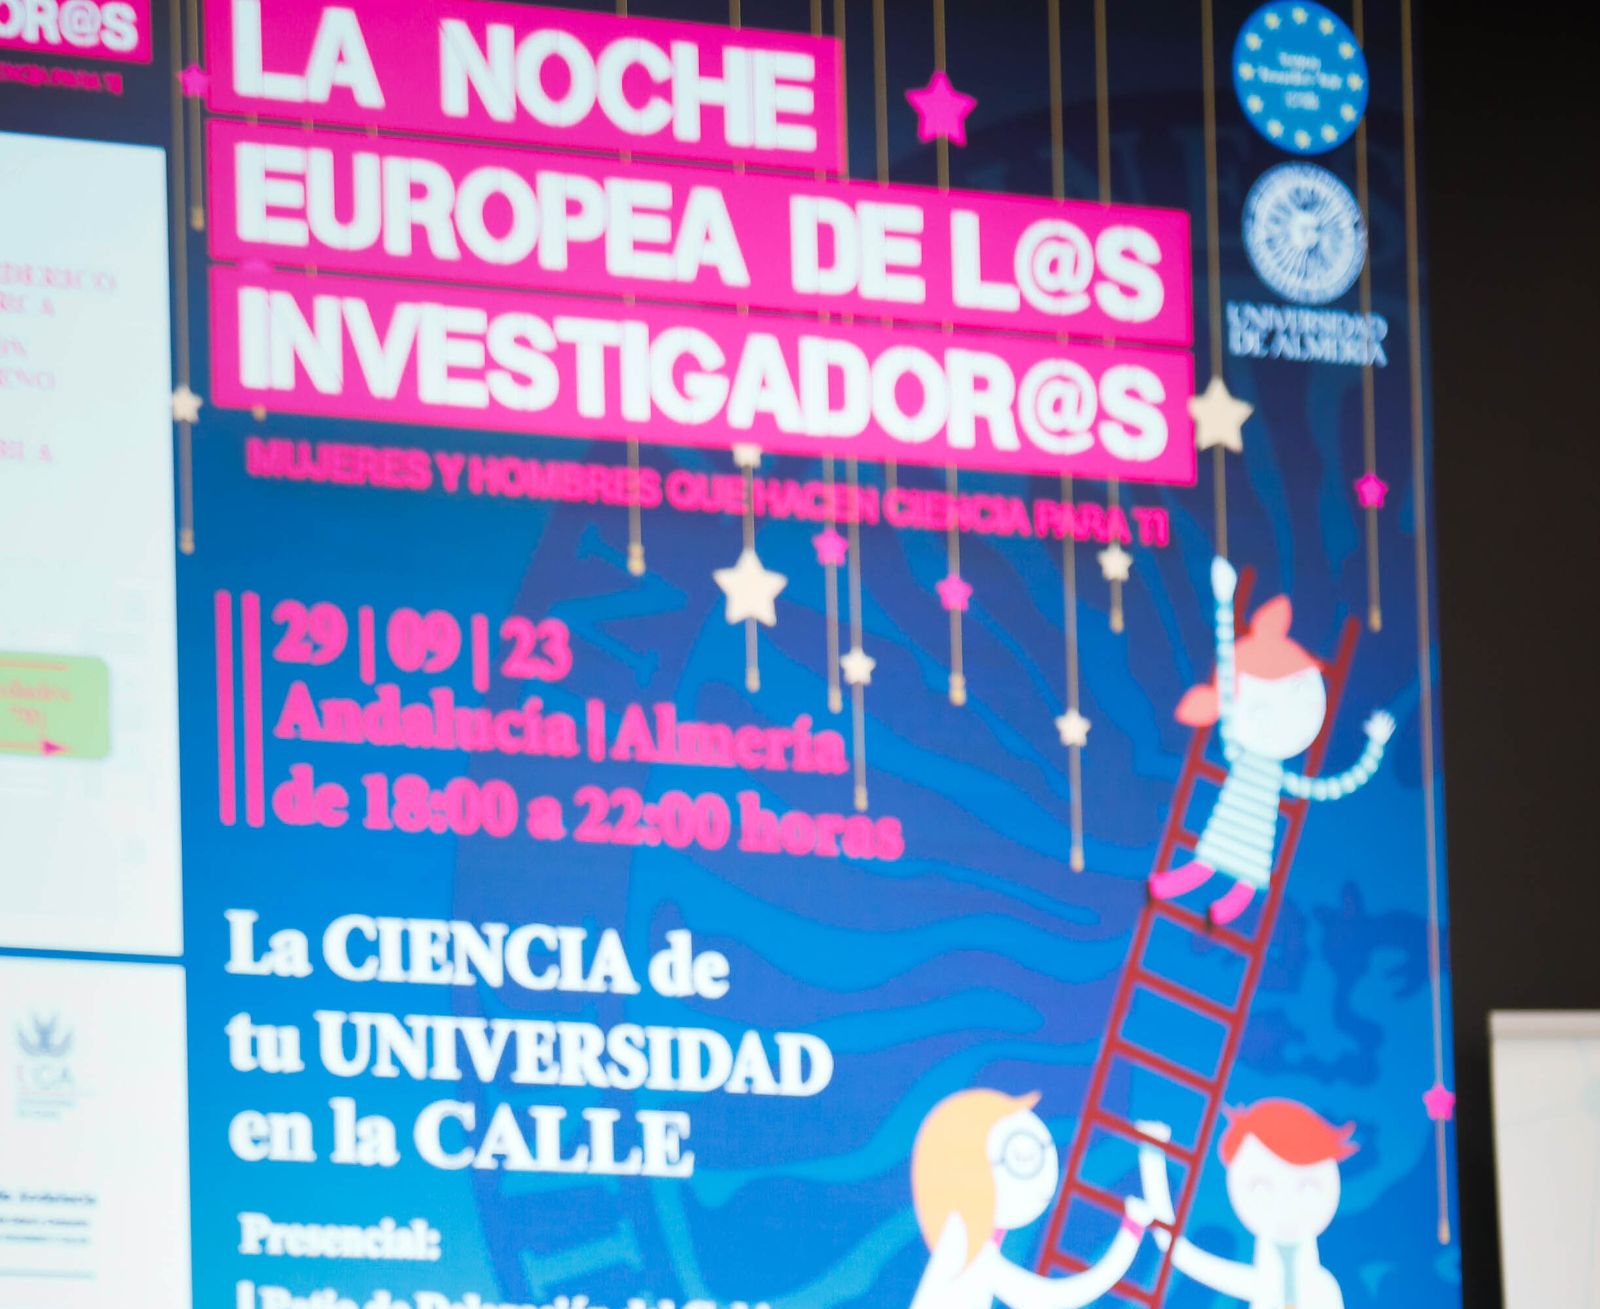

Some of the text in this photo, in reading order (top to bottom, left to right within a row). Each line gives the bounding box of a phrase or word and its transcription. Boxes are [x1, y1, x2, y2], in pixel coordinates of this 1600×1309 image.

[233, 0, 817, 152] LA NOCHE
[234, 142, 1164, 323] EUROPEA DE L@S
[238, 286, 1168, 461] INVESTIGADOR@S
[246, 436, 1169, 548] MUJERES Y HOMBRES QUE HACEN CIENCIA PARA TI
[272, 600, 348, 666] 29
[387, 607, 462, 673] 09
[500, 616, 574, 683] 23
[275, 681, 579, 757] Andalucía
[611, 702, 848, 775] Almería
[272, 763, 905, 860] de 18:00 a 22:00 horas
[224, 909, 730, 1000] La CIENCIA de
[225, 1009, 834, 1098] tu UNIVERSIDAD
[229, 1097, 694, 1179] en la CALLE
[238, 1212, 441, 1262] Presencial:
